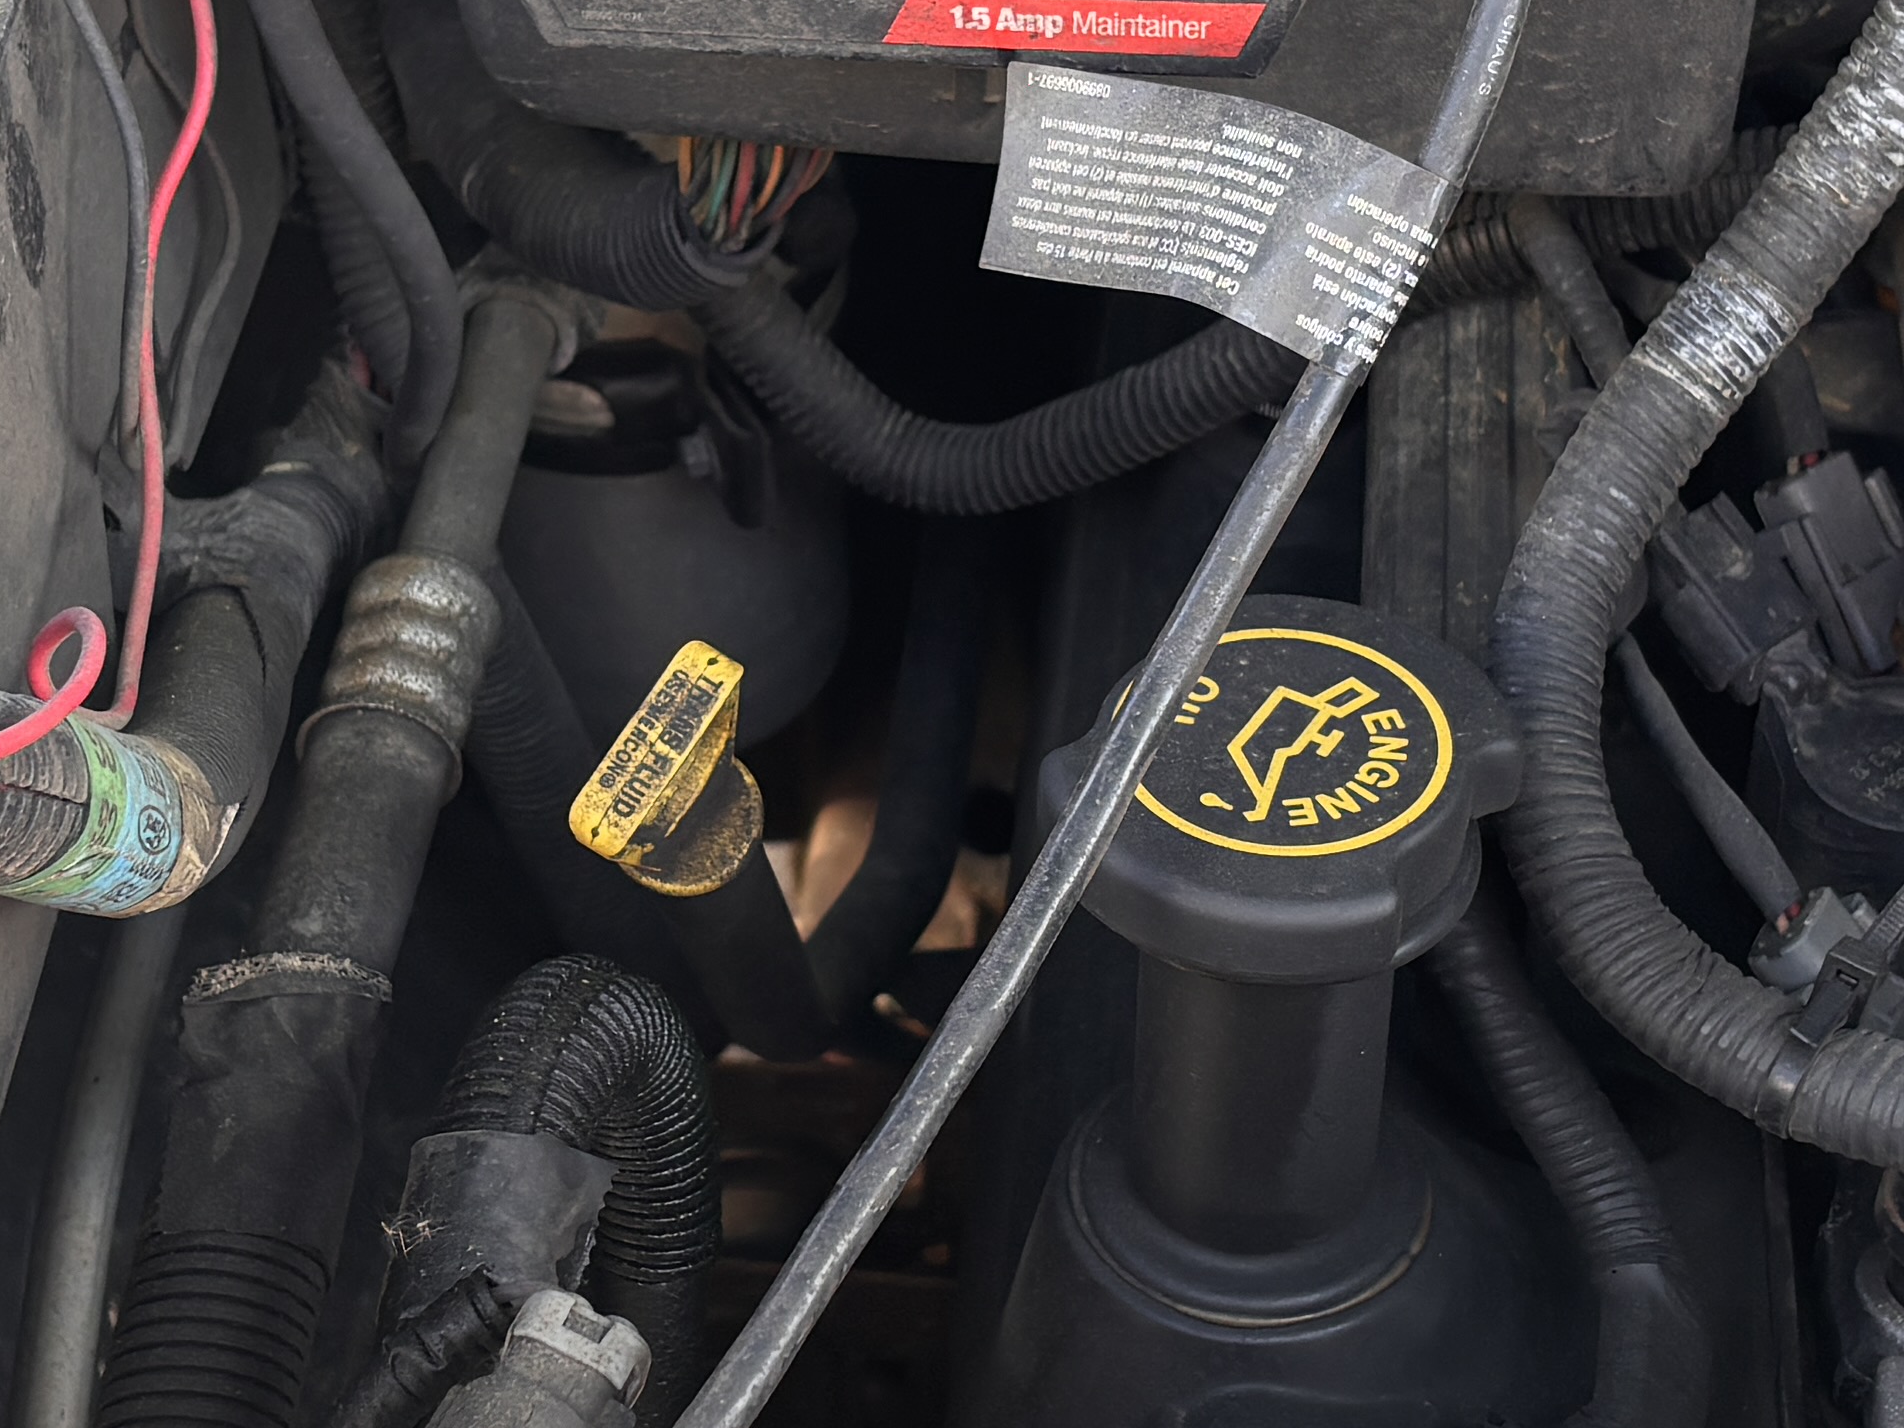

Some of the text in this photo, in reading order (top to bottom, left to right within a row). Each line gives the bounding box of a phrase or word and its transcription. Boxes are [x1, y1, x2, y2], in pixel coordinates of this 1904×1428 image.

[949, 4, 1212, 41] 1.5 Amp Maintainer
[608, 745, 674, 824] FLUID
[1282, 708, 1410, 827] ENGINE
